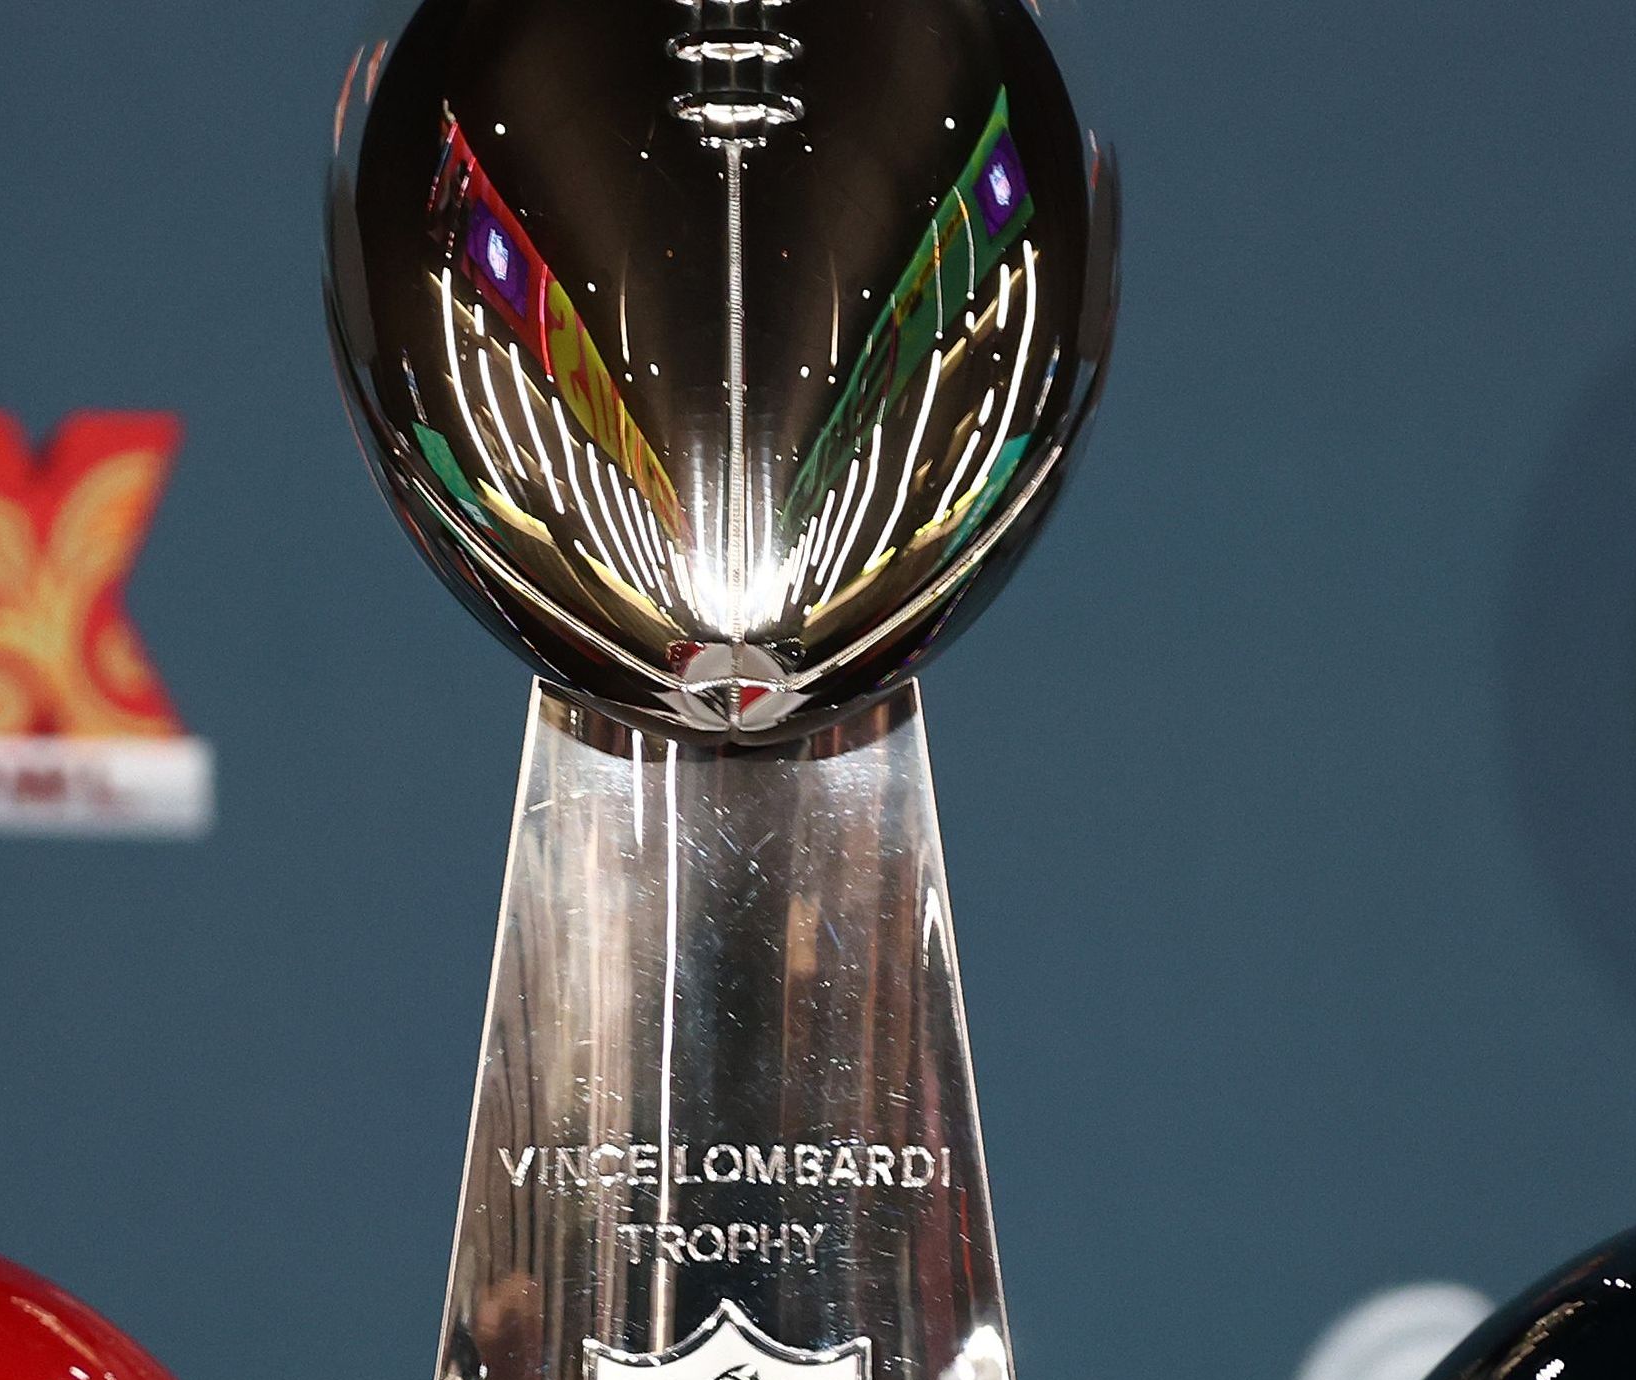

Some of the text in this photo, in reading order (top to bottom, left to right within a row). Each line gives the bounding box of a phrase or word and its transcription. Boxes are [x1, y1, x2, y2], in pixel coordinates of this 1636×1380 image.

[497, 1142, 952, 1189] VINCE LOMBARDI
[616, 1221, 829, 1266] TROPHY
